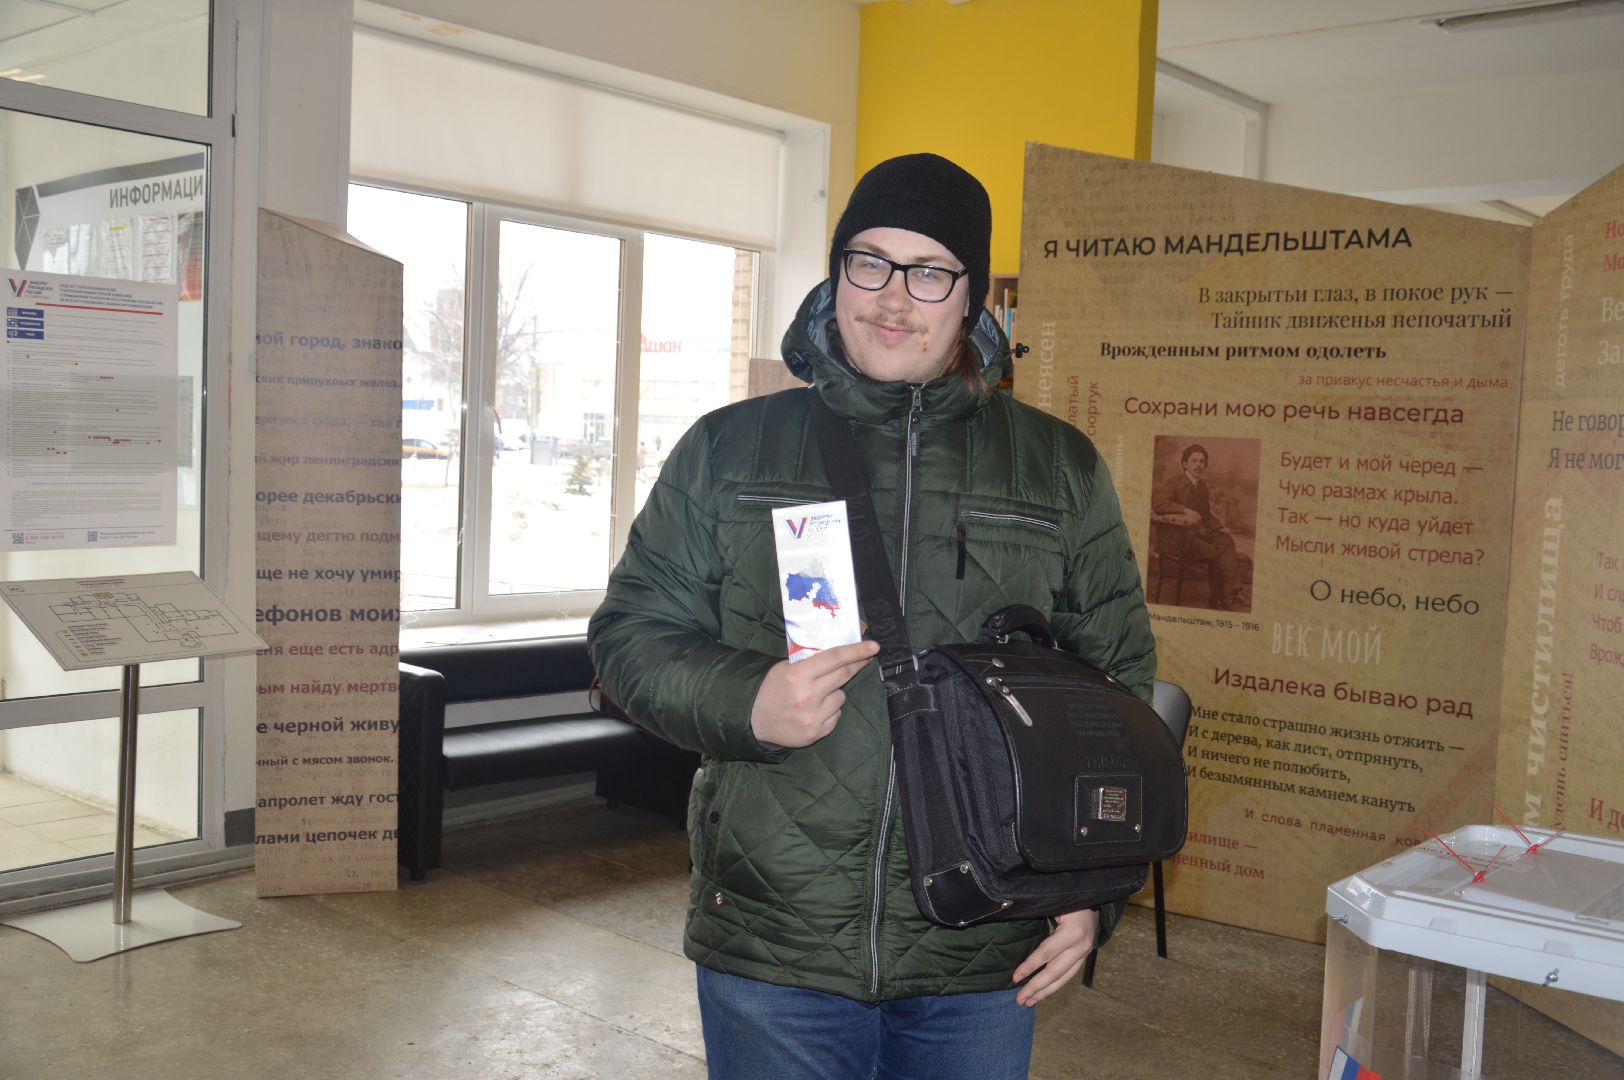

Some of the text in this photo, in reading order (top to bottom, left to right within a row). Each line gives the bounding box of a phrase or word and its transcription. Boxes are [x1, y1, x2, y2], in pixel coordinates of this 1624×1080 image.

[1043, 227, 1413, 258] Я ЧИТАЮ МАНДЕЛЬШТАМА
[1199, 287, 1210, 304] В
[1215, 287, 1307, 306] закрытьи
[1313, 287, 1358, 305] глаз,
[1365, 288, 1376, 301] в
[1383, 286, 1444, 301] покое
[1450, 285, 1488, 304] рук
[1211, 307, 1512, 331] Тайник движенья непочатый
[290, 335, 346, 350] город,
[1100, 341, 1387, 361] Врожденным ритмом одолеть
[1038, 322, 1056, 407] неясен
[1298, 375, 1509, 390] за привкус несчастья и дыма
[1067, 374, 1080, 426] латый
[1087, 381, 1101, 437] сюртук
[1124, 397, 1464, 425] Сохрани мою речь навсегда
[1552, 411, 1574, 431] Не
[1281, 451, 1332, 470] Будет
[1339, 457, 1349, 470] и
[1357, 455, 1393, 471] мой
[1400, 460, 1457, 477] черед
[1548, 448, 1560, 468] Я
[1564, 453, 1585, 469] не
[1279, 480, 1458, 506] Чую размах крыла.
[1277, 508, 1309, 524] Так
[1339, 514, 1361, 528] но
[1368, 517, 1410, 535] куда
[1417, 515, 1474, 536] уйдет
[306, 531, 356, 545] дегтю
[1276, 535, 1484, 565] Мысли живой стрела?
[1597, 551, 1619, 571] Так
[288, 570, 310, 580] не
[314, 569, 354, 583] хочу
[1310, 579, 1480, 615] О небо, небо
[1215, 618, 1233, 629] 1915
[289, 645, 324, 657] еще
[329, 644, 365, 656] есть
[1272, 622, 1383, 665] ВЕК МОЙ
[256, 683, 285, 695] ым
[290, 680, 342, 696] найду
[1214, 667, 1474, 719] Издалека бываю рад
[273, 716, 344, 736] черной
[1191, 706, 1219, 721] Мне
[1221, 712, 1260, 726] стало
[1263, 718, 1326, 737] страшно
[1329, 726, 1380, 743] жизнь
[1383, 734, 1445, 752] отжить
[292, 757, 299, 766] с
[302, 756, 343, 765] мясом
[346, 755, 394, 764] звонок.
[1188, 725, 1424, 773] И с дерева, как лист, отпрянуть,
[1187, 745, 1351, 784] И ничего не полюбить,
[331, 794, 364, 806] жду
[1200, 766, 1296, 793] безымянным
[1299, 784, 1359, 804] камнем
[1361, 795, 1416, 813] кануть
[1589, 797, 1605, 821] И
[305, 830, 378, 844] цепочек
[1261, 812, 1302, 828] слова
[1310, 821, 1386, 842] пламенная
[1234, 864, 1265, 879] дом
